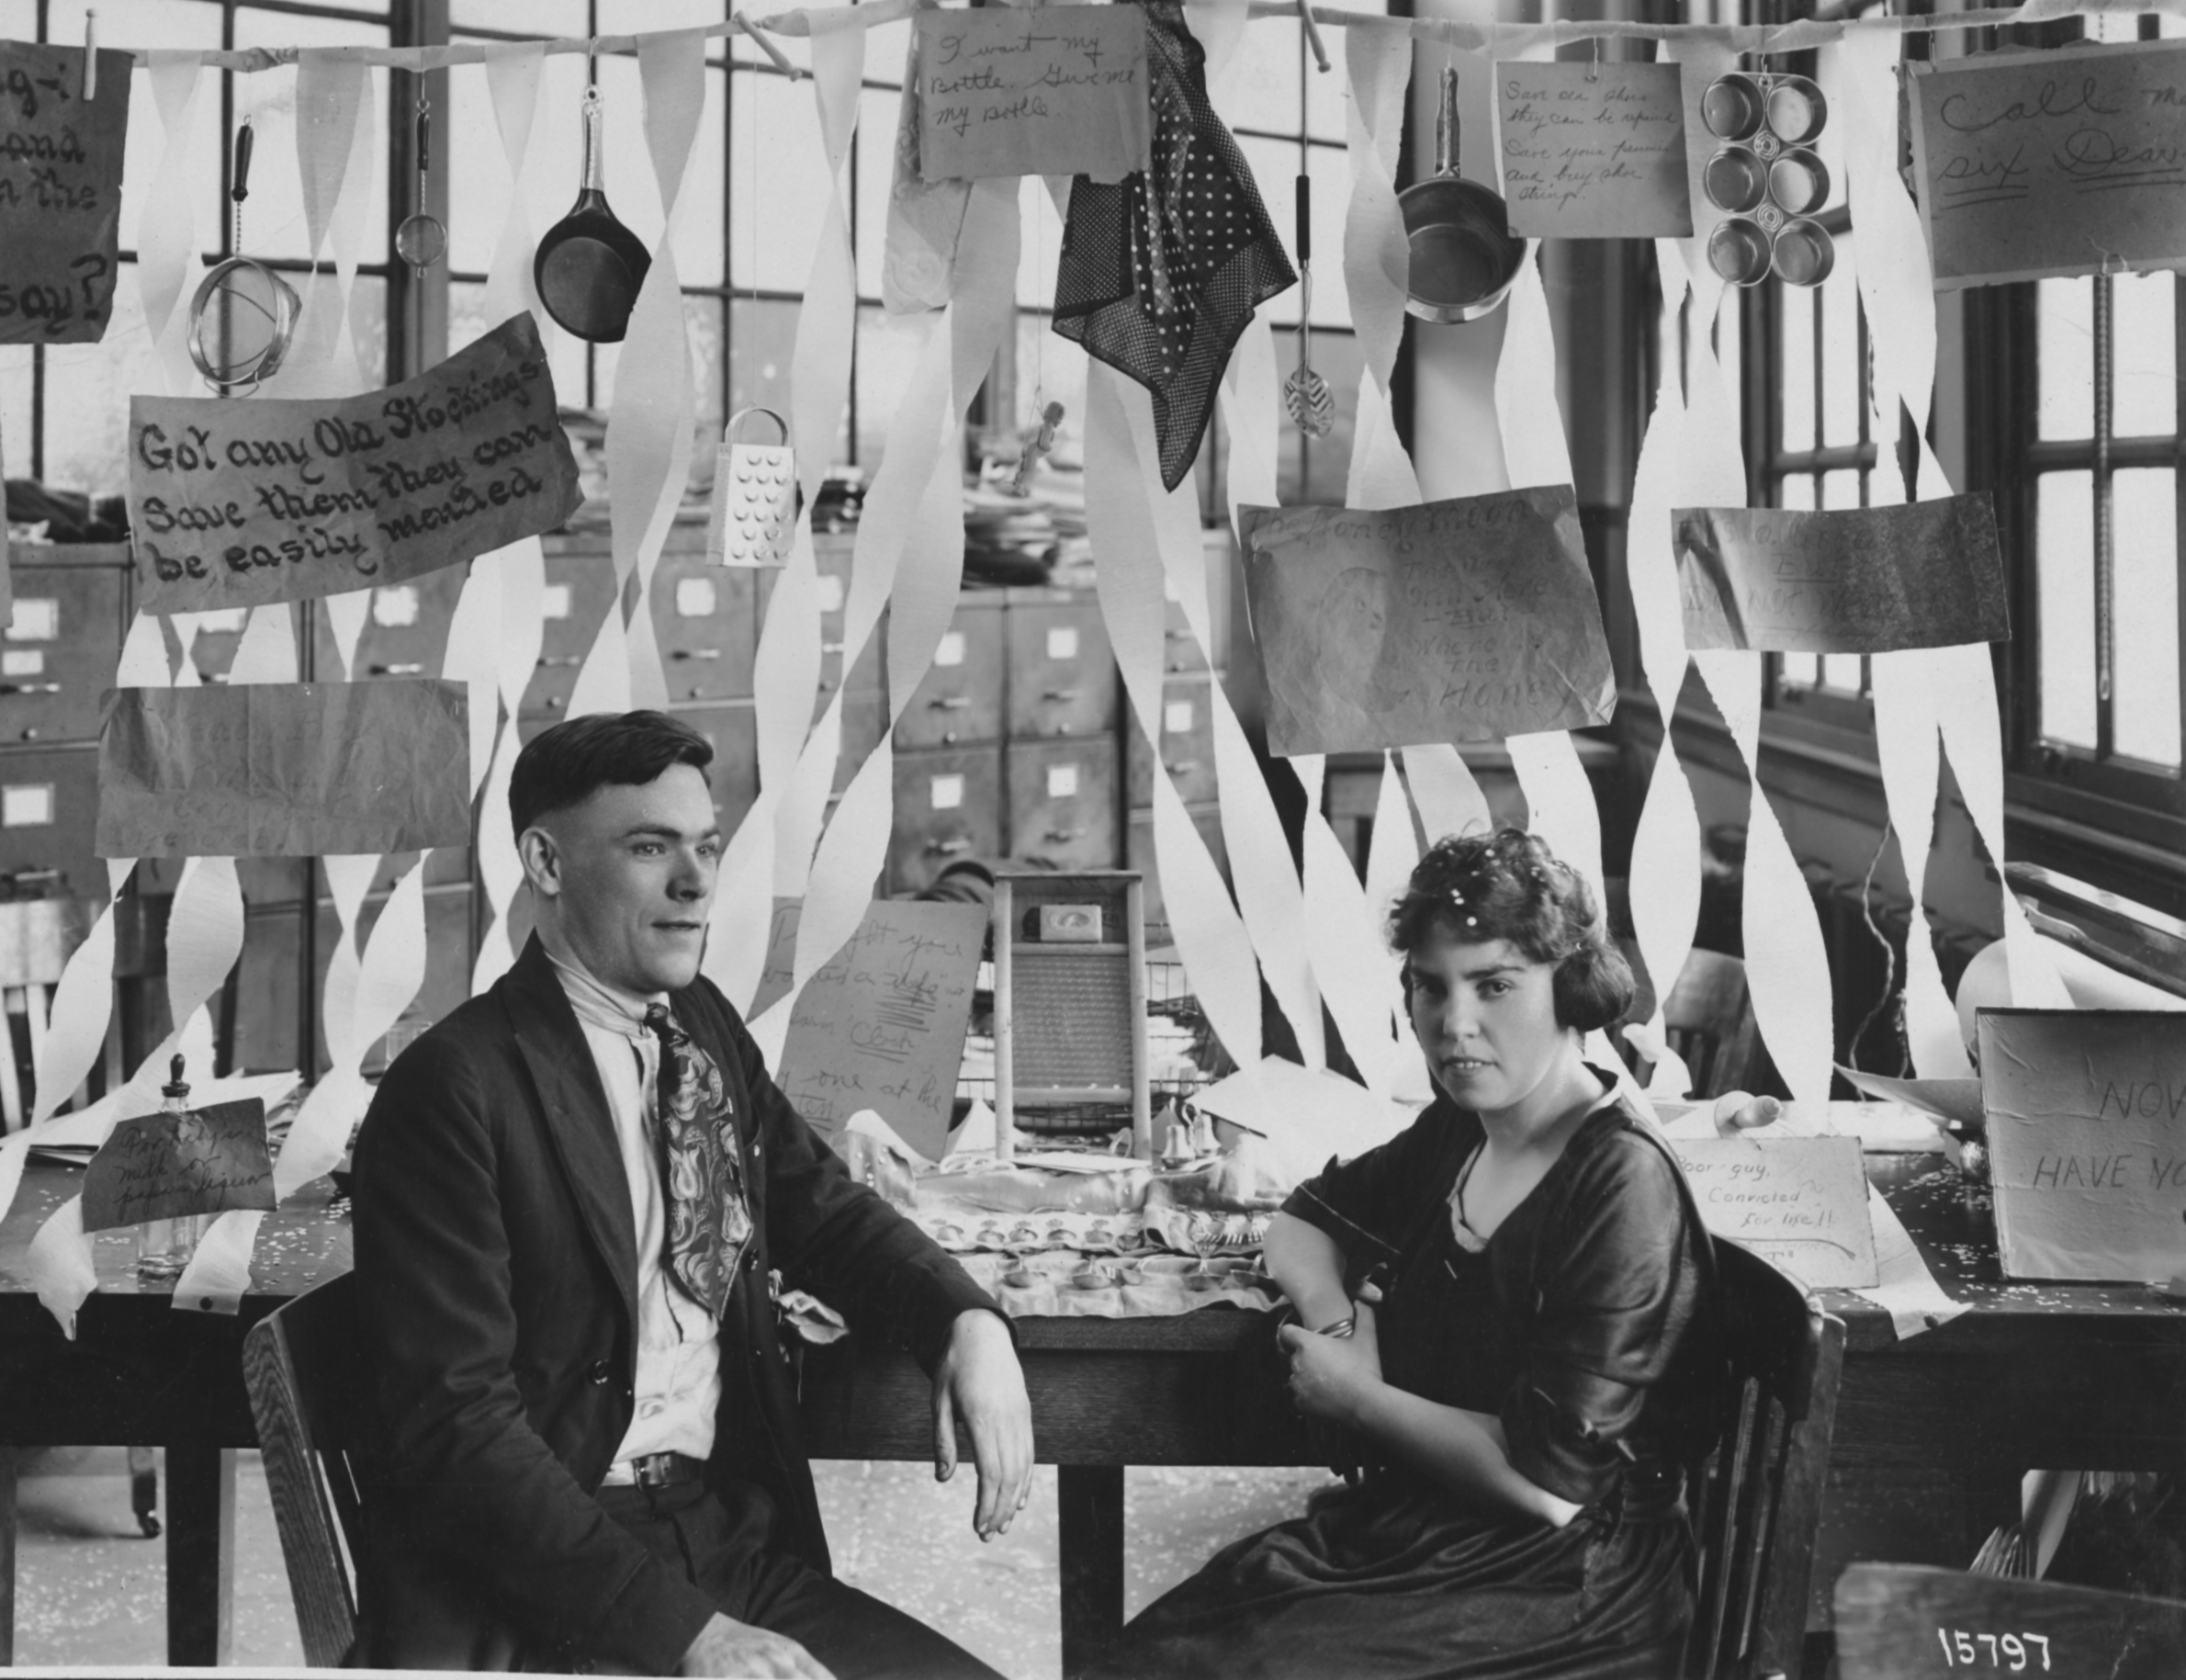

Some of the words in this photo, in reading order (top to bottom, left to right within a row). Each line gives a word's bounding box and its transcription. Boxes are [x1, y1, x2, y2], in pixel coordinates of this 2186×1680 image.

[938, 32, 968, 64] I
[969, 32, 1056, 57] want
[1062, 37, 1104, 68] my
[1023, 62, 1098, 89] Give
[1100, 70, 1135, 85] me
[1505, 81, 1548, 101] Save
[1558, 89, 1588, 102] old
[1507, 103, 1548, 139] they
[1549, 112, 1583, 124] can
[1594, 107, 1614, 124] be
[1941, 77, 2122, 131] Call
[933, 107, 972, 138] my
[1504, 139, 1551, 159] Save
[1560, 147, 1606, 166] your
[1936, 143, 2030, 190] six
[29, 167, 96, 209] the
[1505, 169, 1545, 183] and
[1553, 164, 1594, 193] buy
[1600, 163, 1643, 184] shoe
[140, 423, 217, 474] Got
[227, 437, 324, 484] any
[314, 417, 384, 457] Old
[383, 359, 541, 438] Stockings
[143, 496, 245, 533] Save
[259, 483, 378, 521] them
[368, 457, 468, 499] they
[474, 423, 552, 466] can
[143, 543, 208, 581] be
[224, 524, 377, 576] easily
[378, 467, 542, 543] mended
[899, 934, 963, 975] you
[854, 971, 876, 987] a
[799, 1069, 864, 1091] one
[879, 1078, 912, 1100] at
[918, 1075, 943, 1115] the
[113, 1152, 167, 1184] milk
[179, 1156, 221, 1176] or
[2033, 1155, 2133, 1189] HAVE
[1708, 1187, 1801, 1203] Convicted
[1741, 1212, 1773, 1228] for
